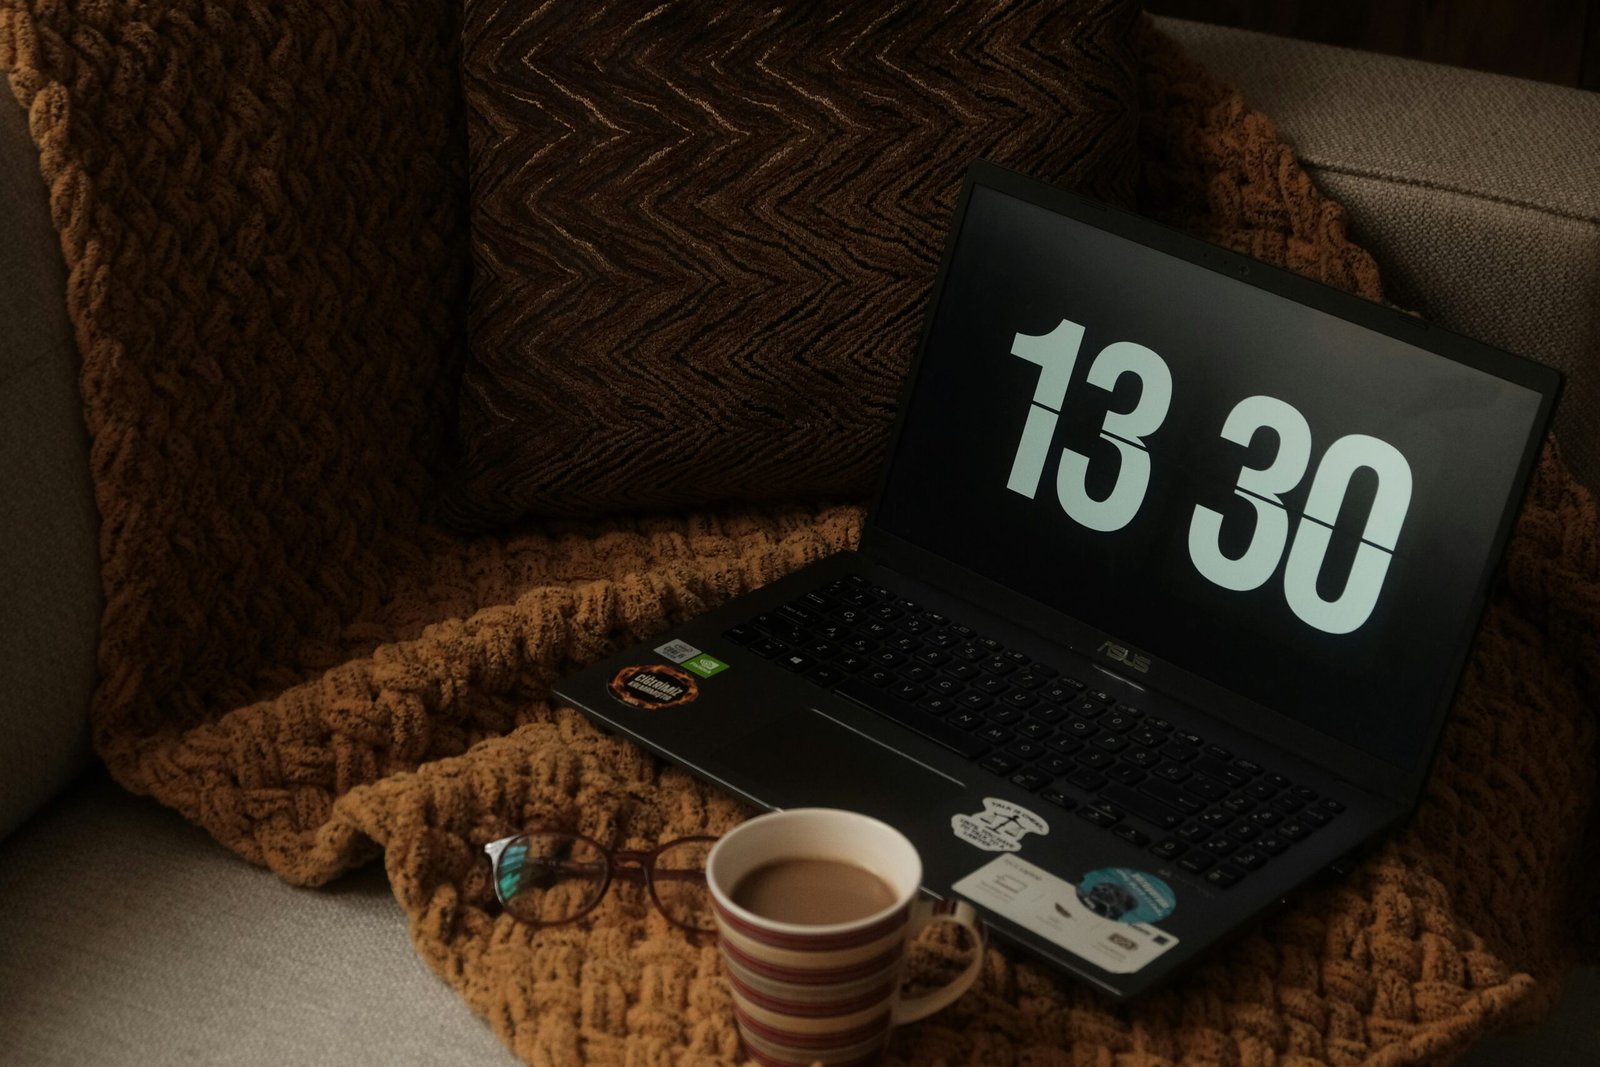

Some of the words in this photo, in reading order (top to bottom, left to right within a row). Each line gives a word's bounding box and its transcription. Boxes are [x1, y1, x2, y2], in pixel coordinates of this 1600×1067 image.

[1006, 318, 1174, 533] 13
[1188, 395, 1413, 635] 30
[1096, 639, 1152, 674] ASUS
